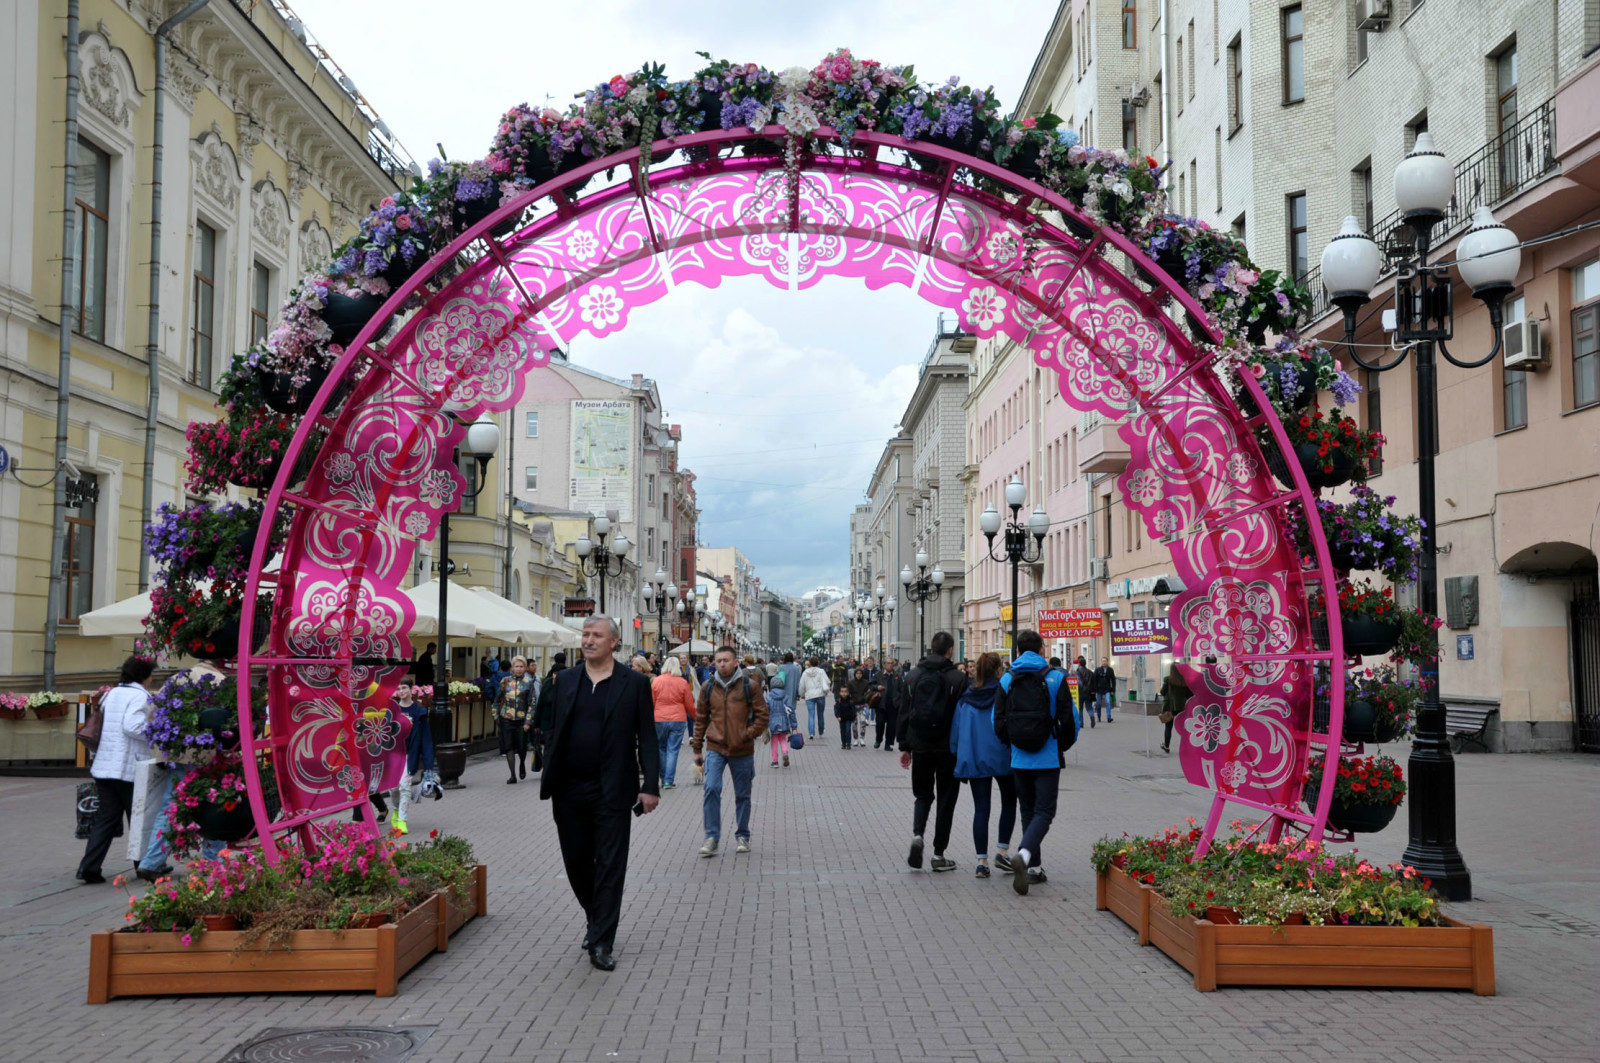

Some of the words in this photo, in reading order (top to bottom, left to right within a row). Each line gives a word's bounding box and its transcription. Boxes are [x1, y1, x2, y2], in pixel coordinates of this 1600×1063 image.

[1039, 610, 1102, 621] МосГорСкупка
[1112, 618, 1169, 633] ЦВЕТЫ
[1048, 629, 1094, 637] ЮВЕЛИР
